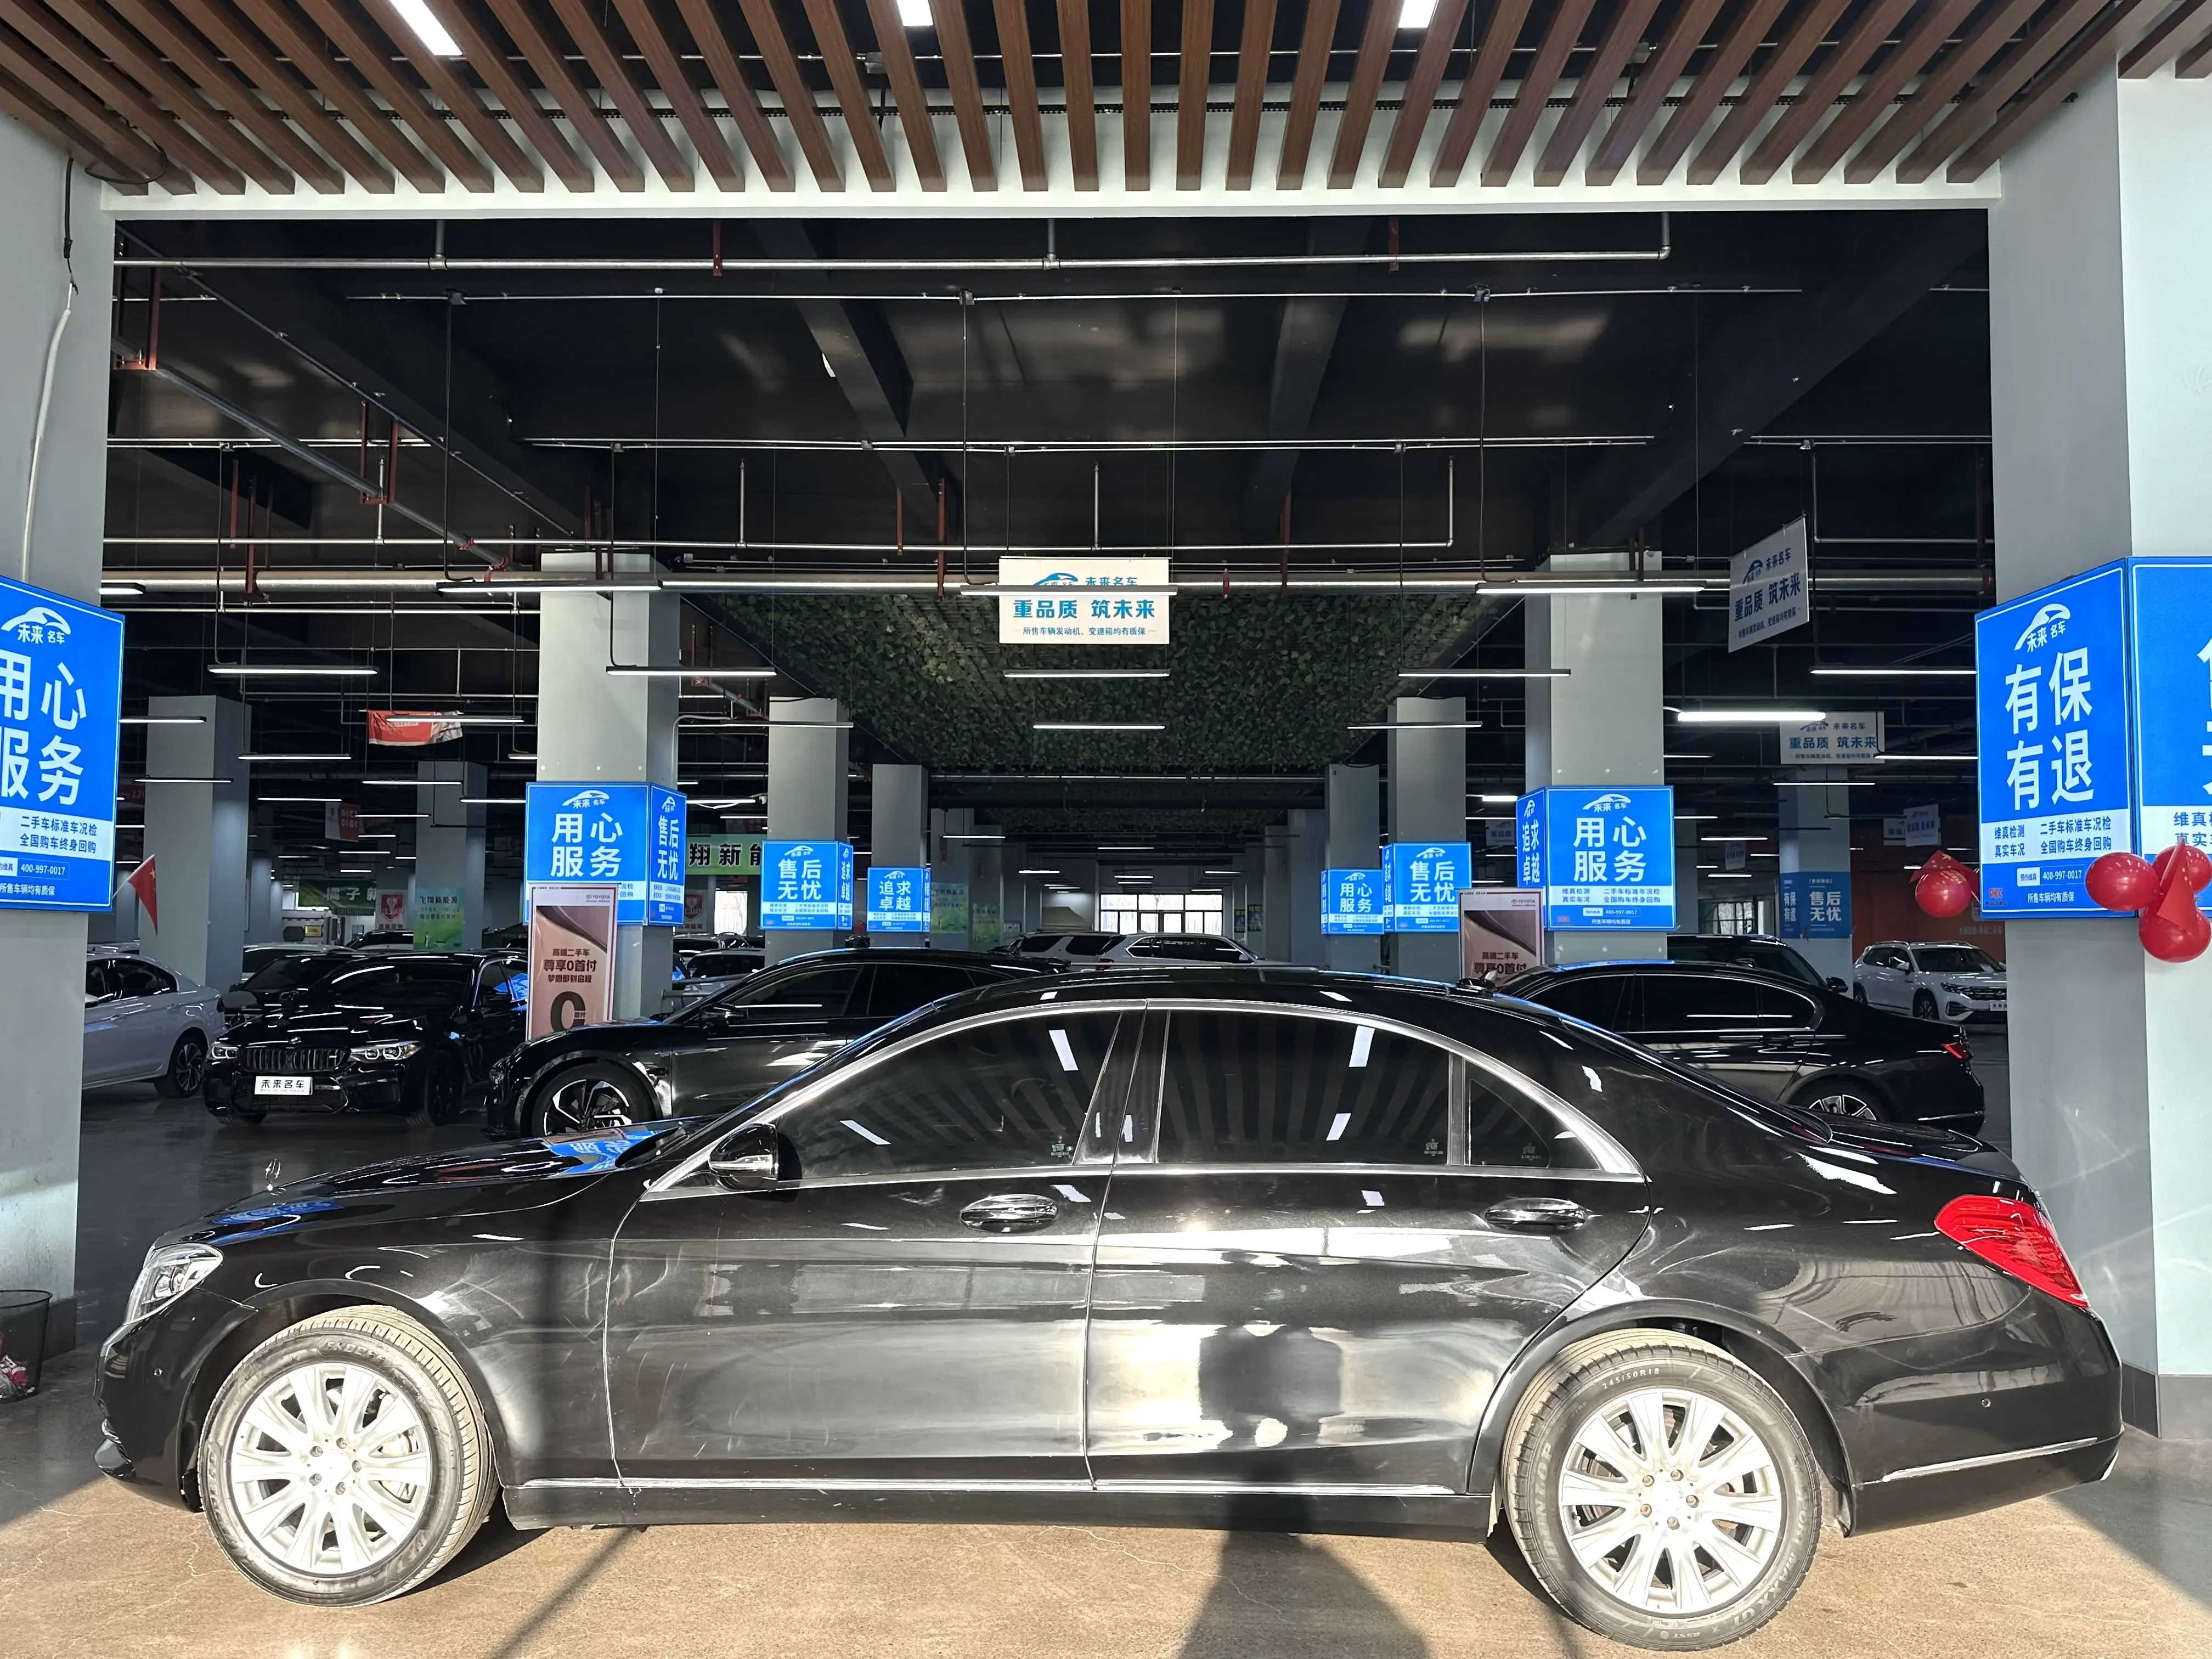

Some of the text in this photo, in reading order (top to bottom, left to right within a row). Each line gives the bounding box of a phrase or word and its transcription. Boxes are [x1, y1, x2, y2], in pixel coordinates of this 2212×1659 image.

[1765, 548, 1791, 571] 未来名车
[1735, 589, 1763, 622] 重品质
[1769, 572, 1800, 605] 筑未来
[1013, 600, 1155, 619] 重品质 筑未来
[18, 623, 65, 645] 未来名车
[1023, 627, 1146, 636] 所售车辆发动机、变速箱均有质保
[2027, 620, 2066, 653] 未来名车
[0, 649, 87, 730] 用心
[2005, 647, 2093, 735] 有保
[1789, 736, 1876, 749] 重品质 筑未来
[0, 726, 83, 805] 服务
[2006, 729, 2094, 810] 有退
[21, 816, 97, 837] 二手车标准车况检
[551, 812, 623, 843] 用心
[2040, 816, 2111, 835] 二手车标准车况检
[2173, 811, 2212, 827] 维真
[658, 815, 679, 849] 售后
[1522, 819, 1539, 853] 追求
[1573, 816, 1647, 848] 用心
[2175, 832, 2212, 847] 真实
[20, 833, 97, 854] 全国购车终身回购
[1995, 836, 2111, 858] 真实车况 全国购车终身回购
[20, 864, 65, 876] 400-997-0017
[550, 846, 622, 877] 服务
[657, 849, 678, 881] 无忧
[778, 859, 822, 879] 售后
[1409, 861, 1455, 882] 售后
[1523, 852, 1540, 885] 卓越
[1573, 850, 1646, 882] 服务
[2042, 870, 2083, 881] 400-997-0017
[777, 880, 822, 900] 无忧
[879, 880, 911, 896] 追求
[1340, 882, 1372, 897] 用心
[1410, 882, 1455, 902] 无忧
[1809, 891, 1841, 906] 售后
[879, 896, 911, 911] 卓越
[1340, 898, 1372, 913] 服务
[1810, 906, 1841, 922] 无忧
[553, 949, 590, 957] 高端二手车
[544, 960, 597, 972] 尊享0首付
[261, 1079, 304, 1088] 未来名车
[1602, 1368, 1660, 1390] 245/50R18
[1535, 1442, 1559, 1557] DUNLOP
